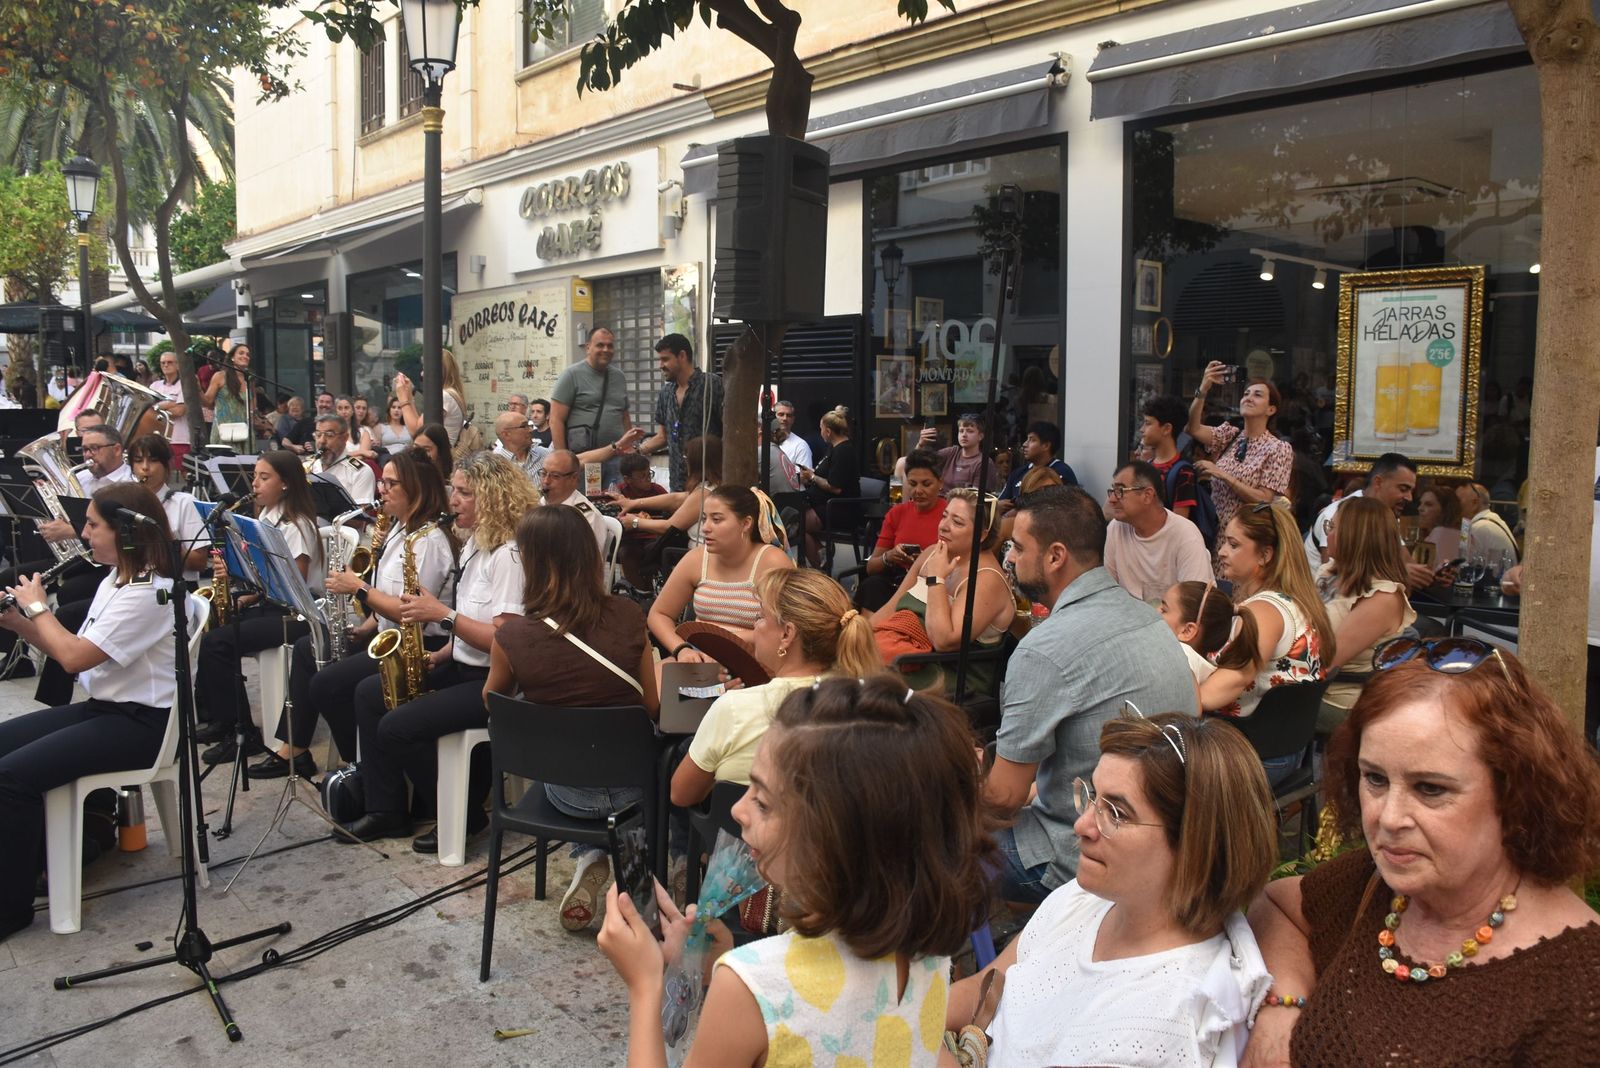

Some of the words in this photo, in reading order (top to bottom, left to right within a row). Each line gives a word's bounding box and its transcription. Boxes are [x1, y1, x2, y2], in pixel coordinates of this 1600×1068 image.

[519, 161, 631, 220] CORREOS
[536, 205, 602, 260] CAFÉ
[459, 300, 516, 345] CORREOS
[518, 302, 559, 338] CAFÉ
[1363, 319, 1456, 344] HELADAS
[1372, 304, 1448, 332] JARRAS
